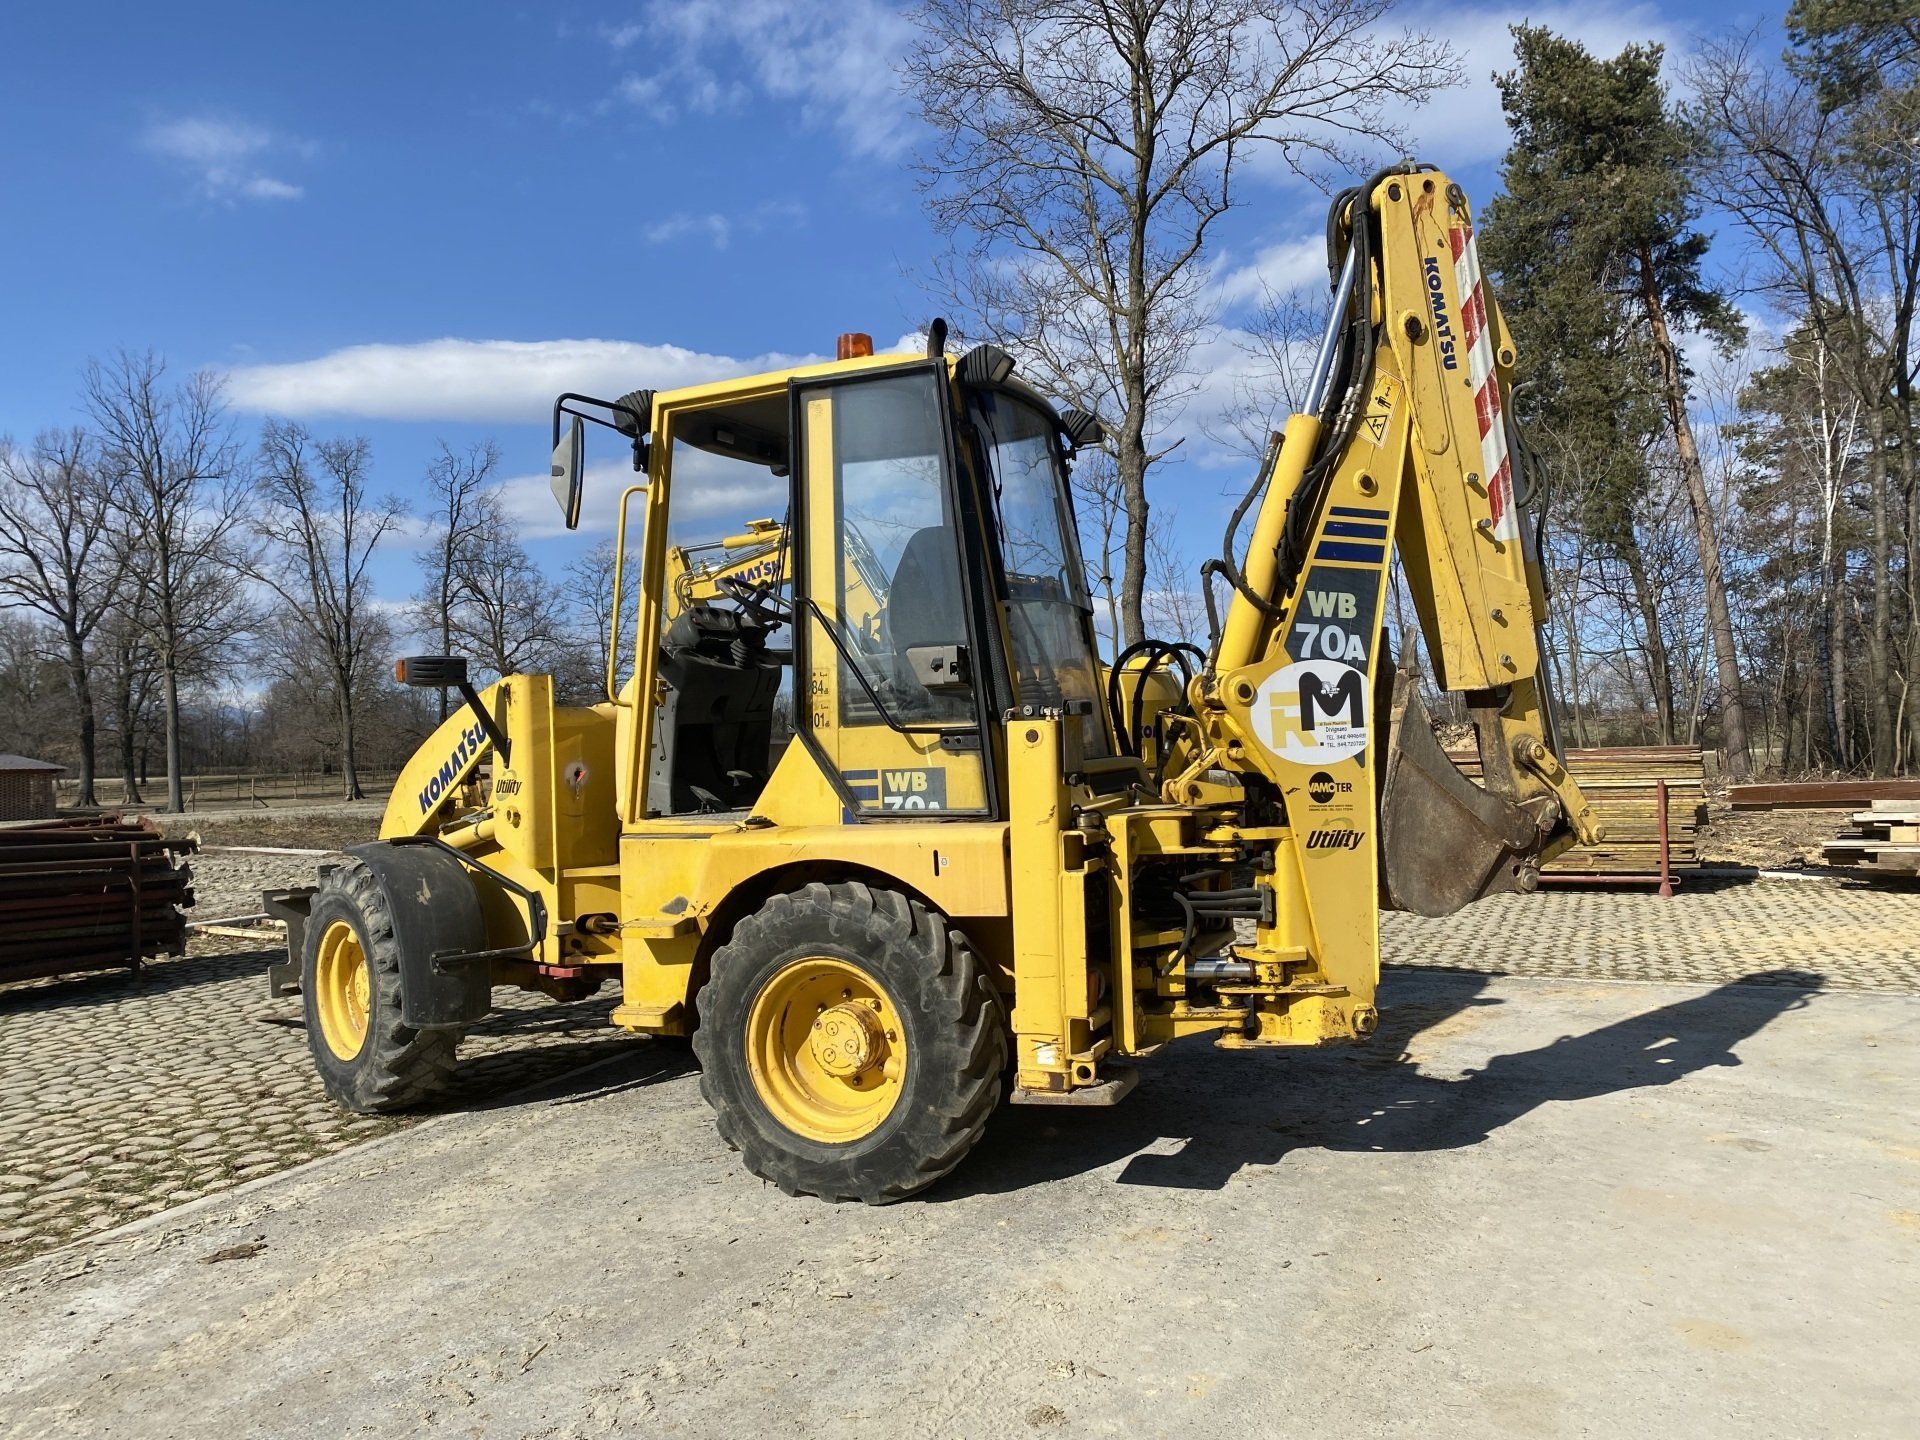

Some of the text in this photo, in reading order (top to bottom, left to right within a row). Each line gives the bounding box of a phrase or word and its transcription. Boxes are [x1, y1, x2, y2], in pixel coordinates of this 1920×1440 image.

[1424, 256, 1457, 371] KOMATSU
[1306, 590, 1357, 619] WB
[1295, 622, 1366, 661] 70A
[418, 720, 487, 815] KOMATSU
[496, 779, 522, 796] Utility
[885, 771, 927, 792] WB
[1308, 782, 1352, 793] VAMOTER
[1306, 828, 1366, 851] Utility
